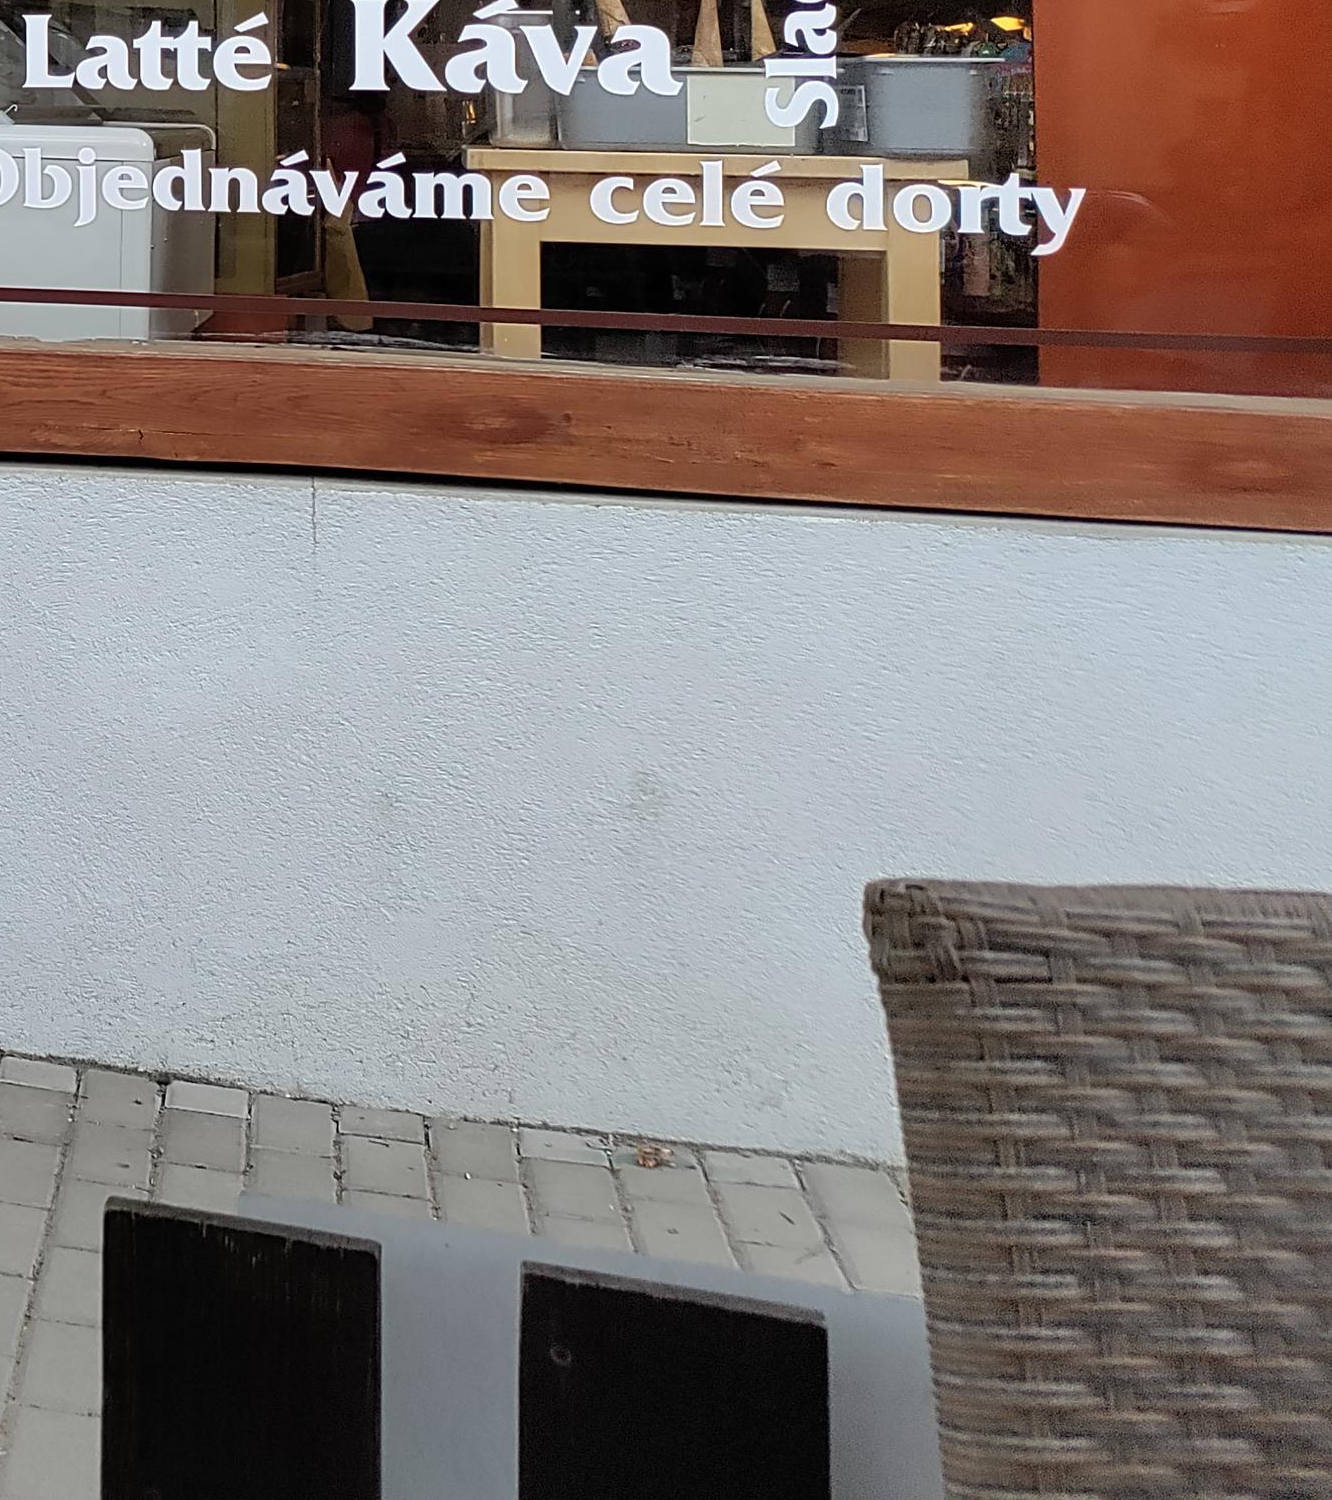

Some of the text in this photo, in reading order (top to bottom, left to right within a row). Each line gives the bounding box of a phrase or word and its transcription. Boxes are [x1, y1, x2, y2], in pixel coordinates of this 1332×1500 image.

[22, 12, 272, 91] Latté
[590, 160, 784, 230] celé
[826, 164, 1086, 257] dorty
